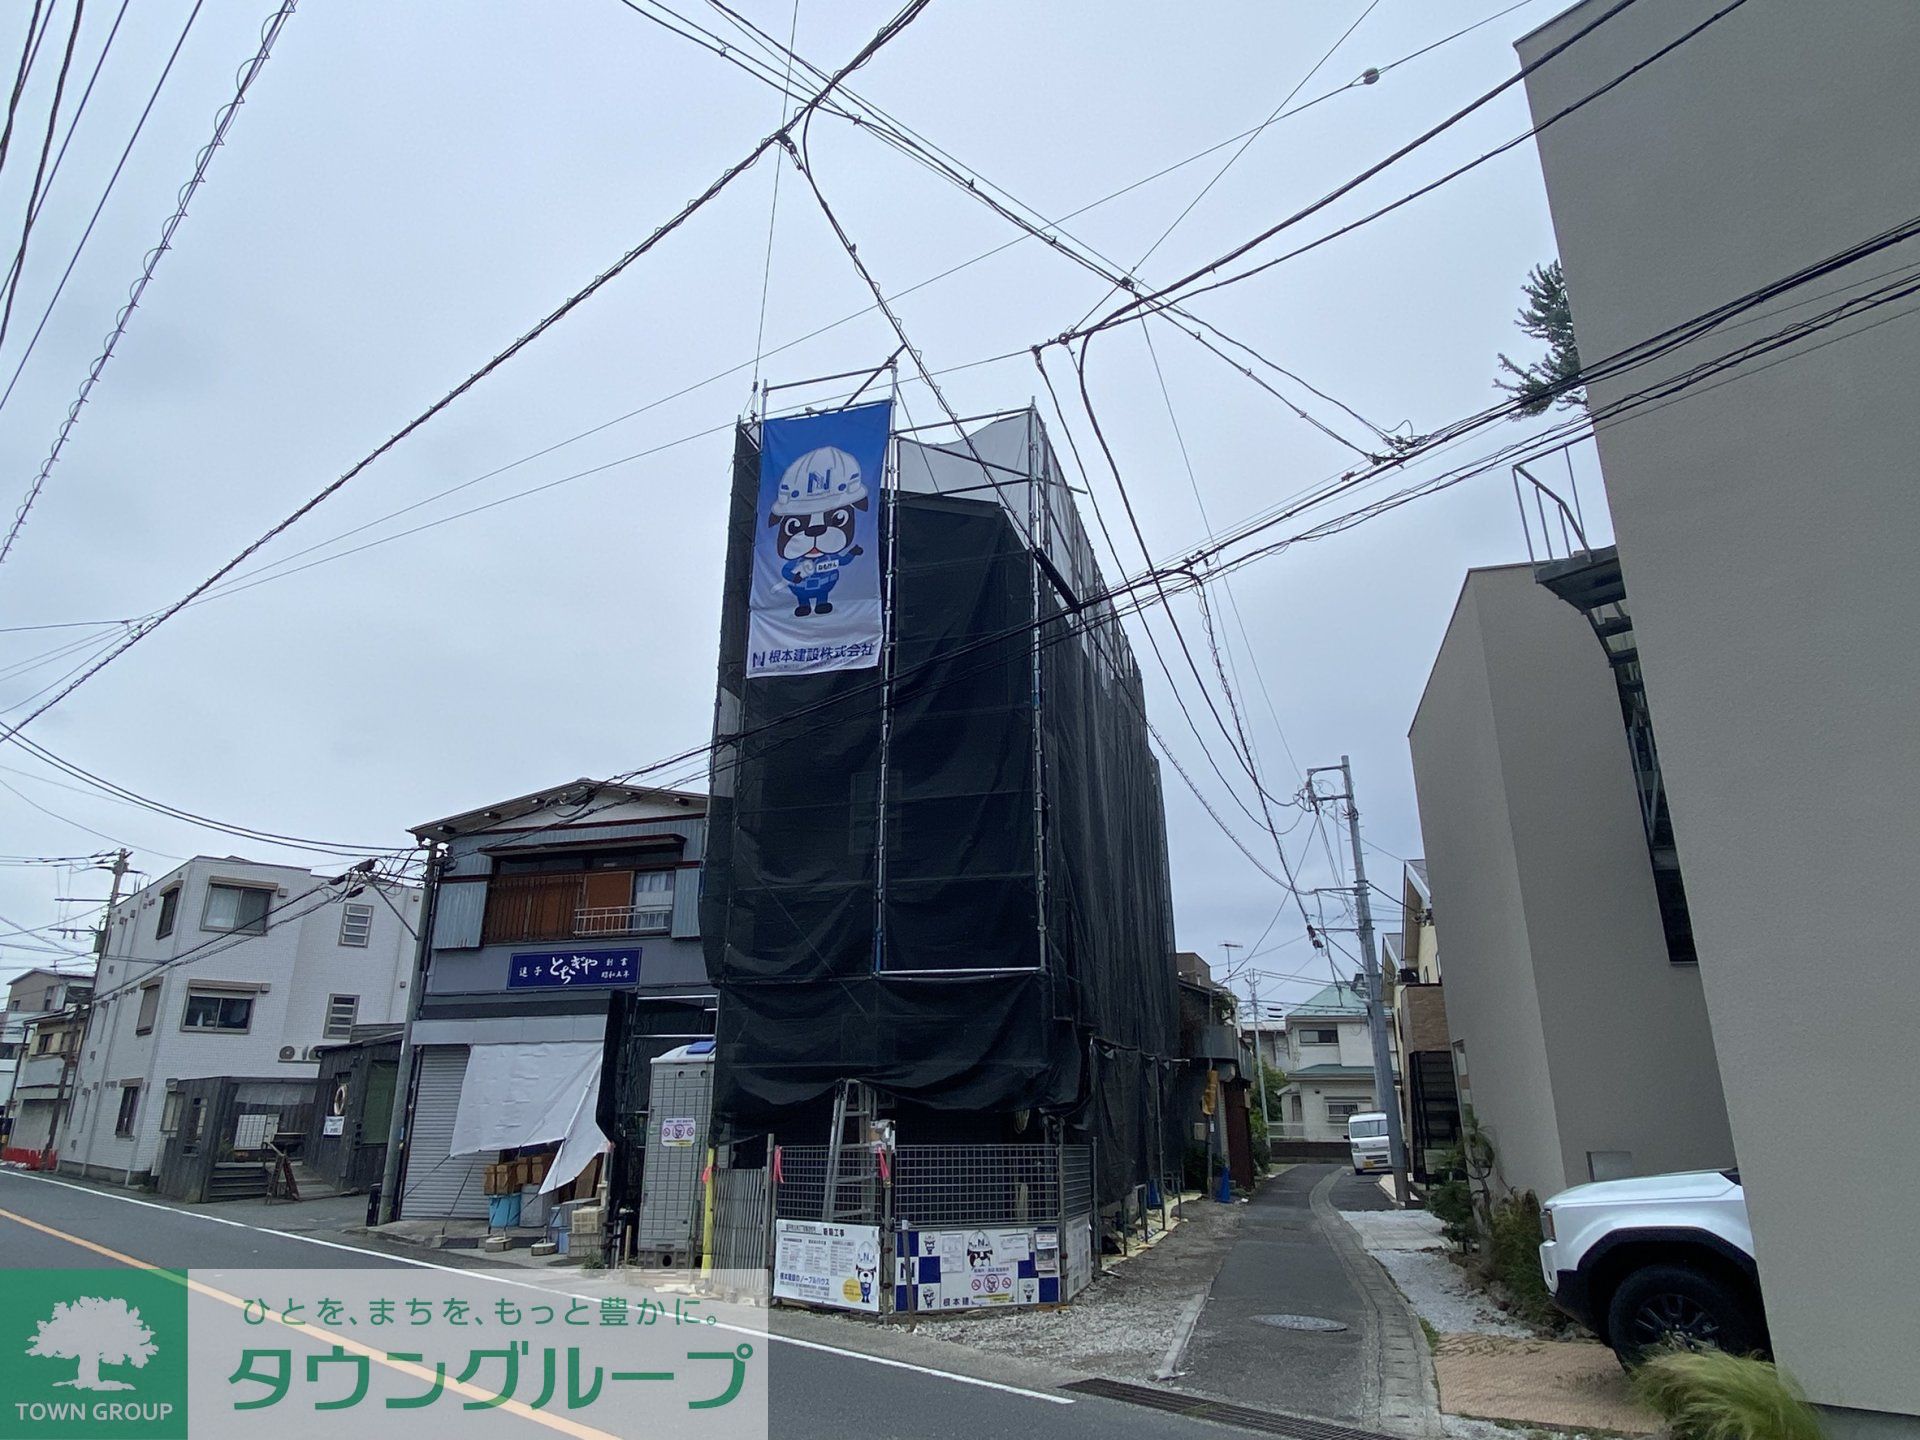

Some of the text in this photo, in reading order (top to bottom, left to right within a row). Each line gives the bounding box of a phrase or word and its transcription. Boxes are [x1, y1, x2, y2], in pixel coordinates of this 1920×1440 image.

[769, 643, 875, 664] 根本建設株式会社
[550, 955, 598, 985] とちぎや
